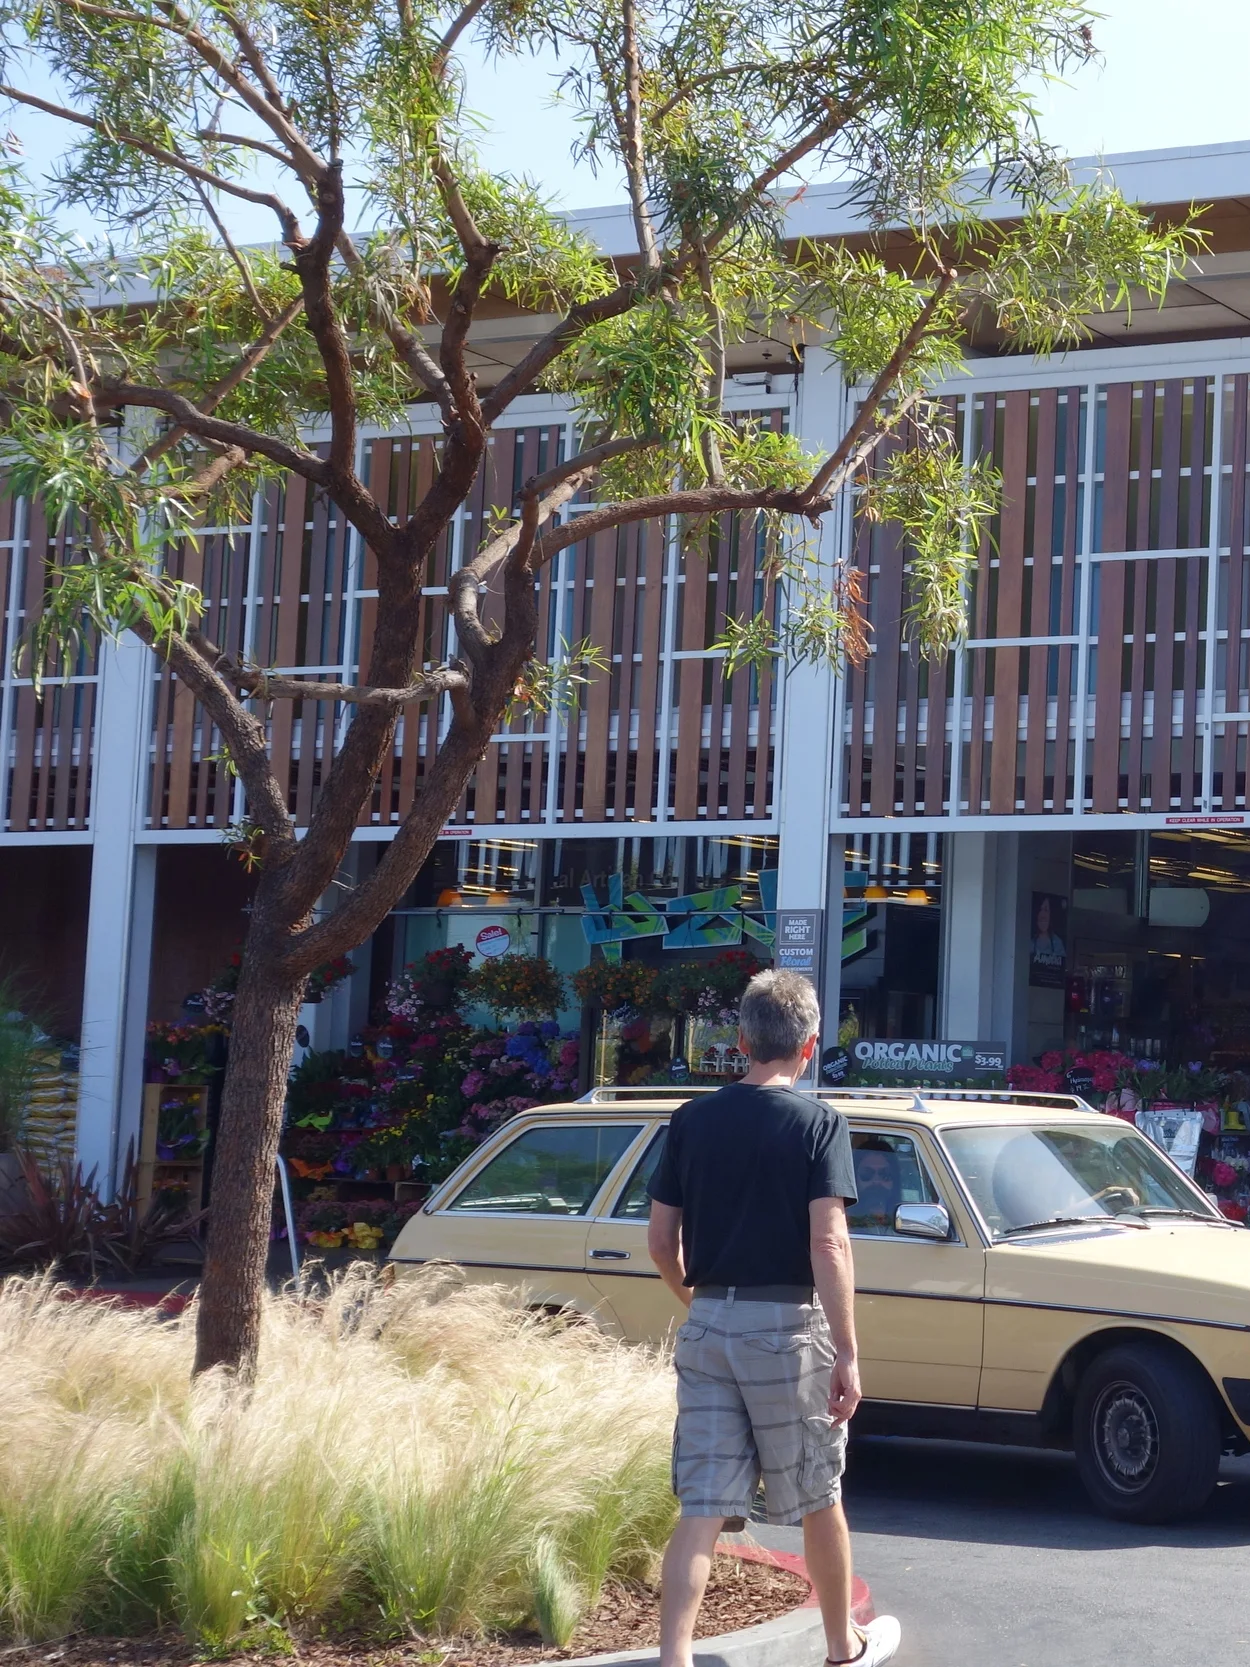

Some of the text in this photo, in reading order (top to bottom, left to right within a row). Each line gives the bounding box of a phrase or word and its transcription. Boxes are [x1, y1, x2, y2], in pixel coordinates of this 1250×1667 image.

[784, 926, 811, 934] RIGHT
[778, 948, 814, 956] CUSTOM
[780, 955, 812, 967] Floral
[855, 1041, 1003, 1067] ORGANIC $3.99
[822, 1055, 848, 1071] ORGANIC
[862, 1057, 906, 1070] Potted
[907, 1058, 954, 1073] Plants
